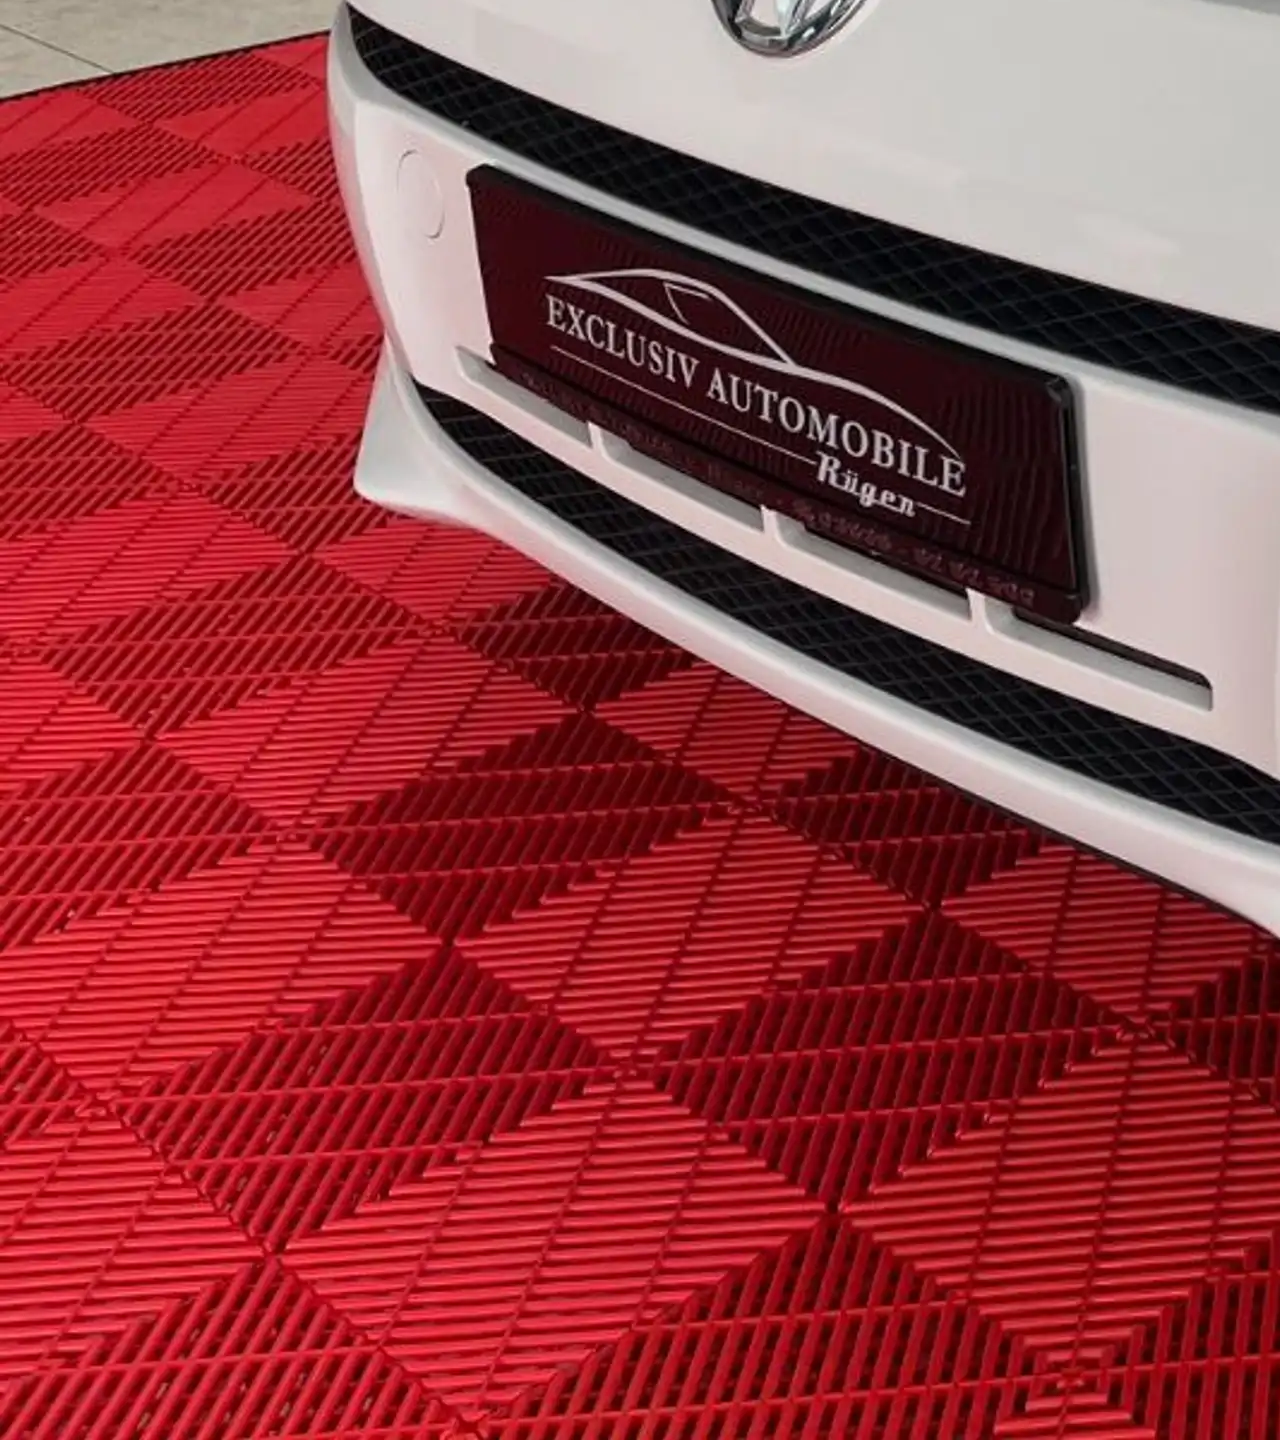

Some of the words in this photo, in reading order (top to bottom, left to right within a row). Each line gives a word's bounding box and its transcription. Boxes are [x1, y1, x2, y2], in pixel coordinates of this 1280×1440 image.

[544, 294, 700, 389] EXCLUSIV
[707, 367, 967, 498] AUTOMOBILE
[814, 450, 917, 518] Rügen
